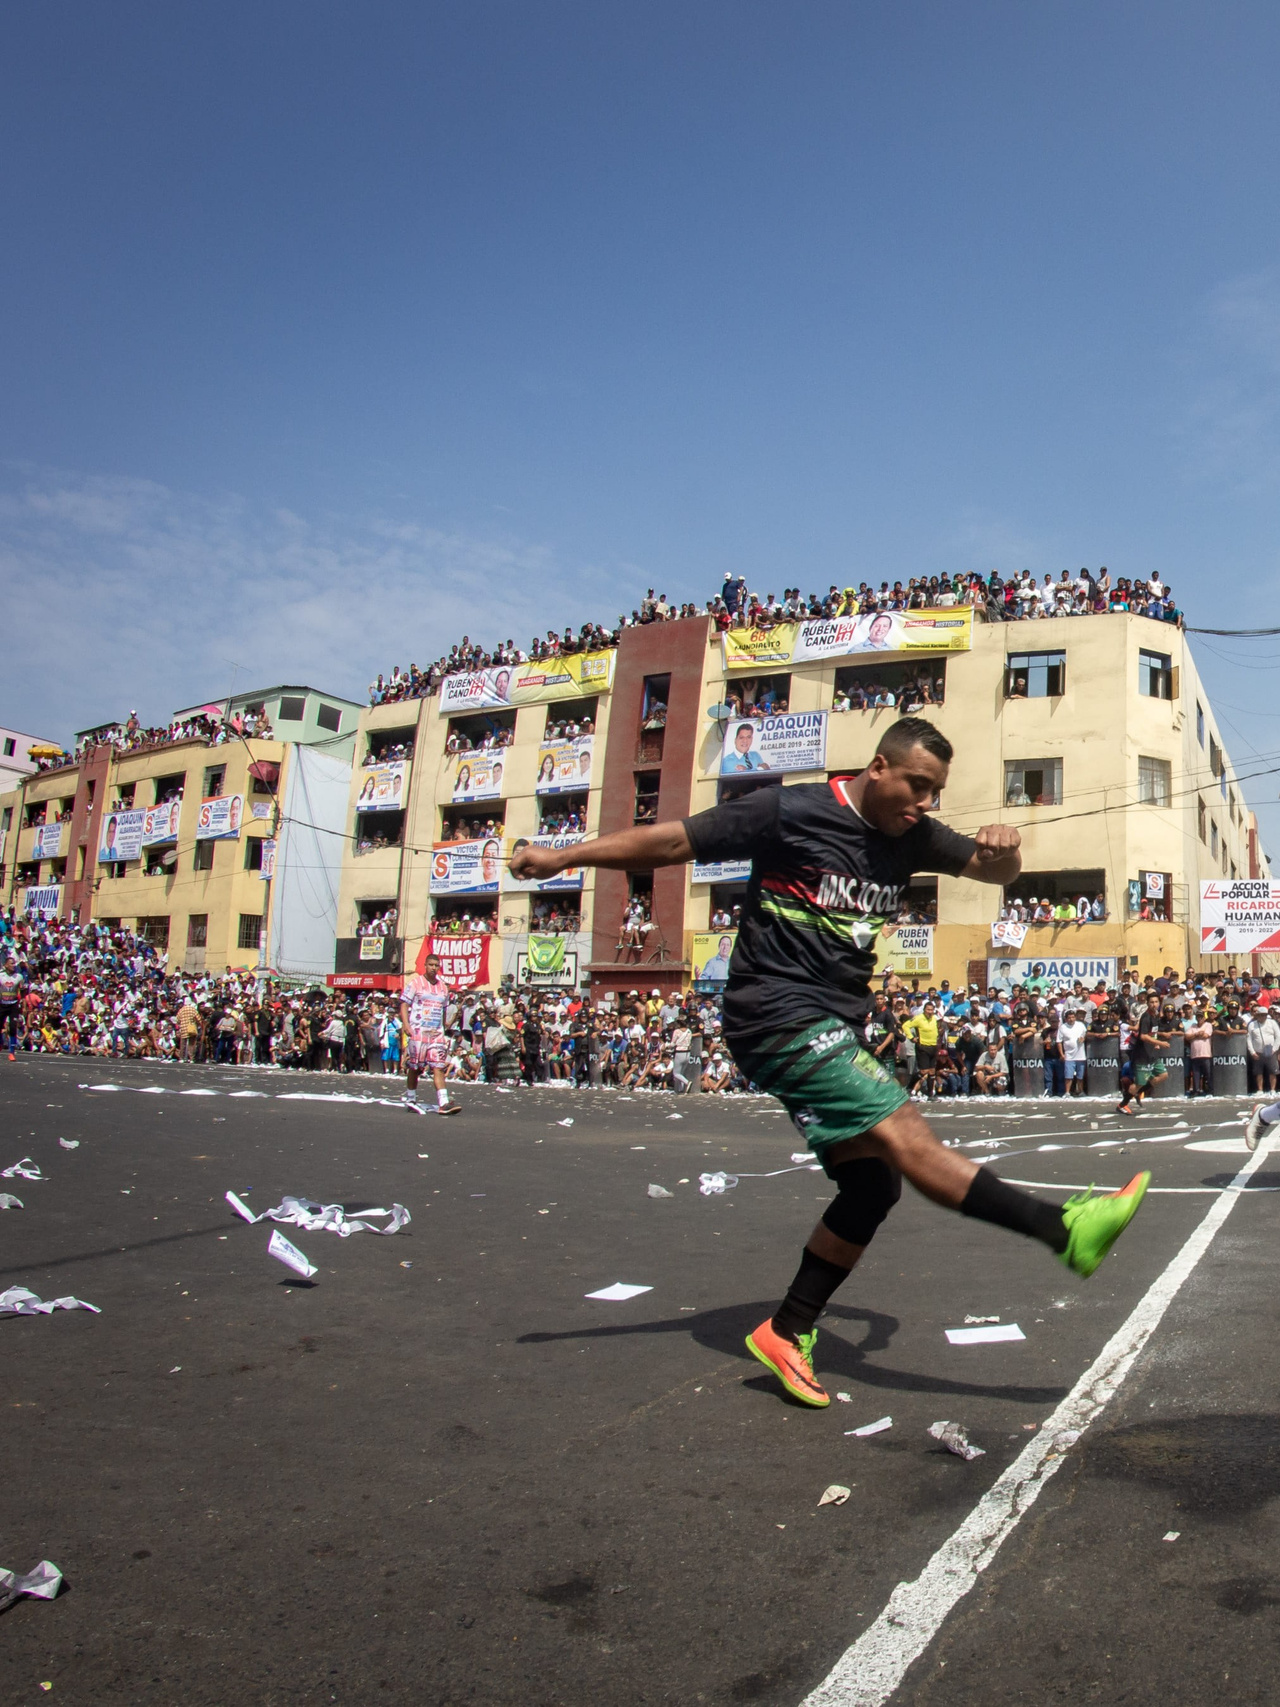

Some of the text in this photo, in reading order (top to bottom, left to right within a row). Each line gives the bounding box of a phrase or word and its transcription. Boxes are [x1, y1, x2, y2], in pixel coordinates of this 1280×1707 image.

[802, 622, 838, 637] RUBÉN
[840, 623, 854, 633] 20
[750, 631, 766, 642] 68
[806, 635, 835, 647] CANO
[838, 633, 851, 641] 18
[448, 689, 469, 699] CANO
[757, 714, 823, 732] JOAQUIN
[760, 728, 821, 741] ALBARRACIN
[760, 742, 786, 750] ALCALDE
[117, 813, 143, 826] JOAQUIN
[456, 845, 478, 853] VICTOR
[816, 874, 857, 910] MAC
[1231, 882, 1269, 891] ACCION
[1221, 890, 1270, 899] POPULAR
[898, 925, 929, 938] RUBÉN
[432, 938, 482, 956] VAMOS
[902, 939, 928, 948] CANO
[438, 954, 481, 974] ERÚ
[1022, 961, 1109, 978] JOAQUIN
[333, 977, 362, 985] LIVESPORT
[1013, 1058, 1043, 1068] POLICÍA
[1087, 1057, 1118, 1068] POLICÍA
[1213, 1055, 1246, 1066] POLICÍA
